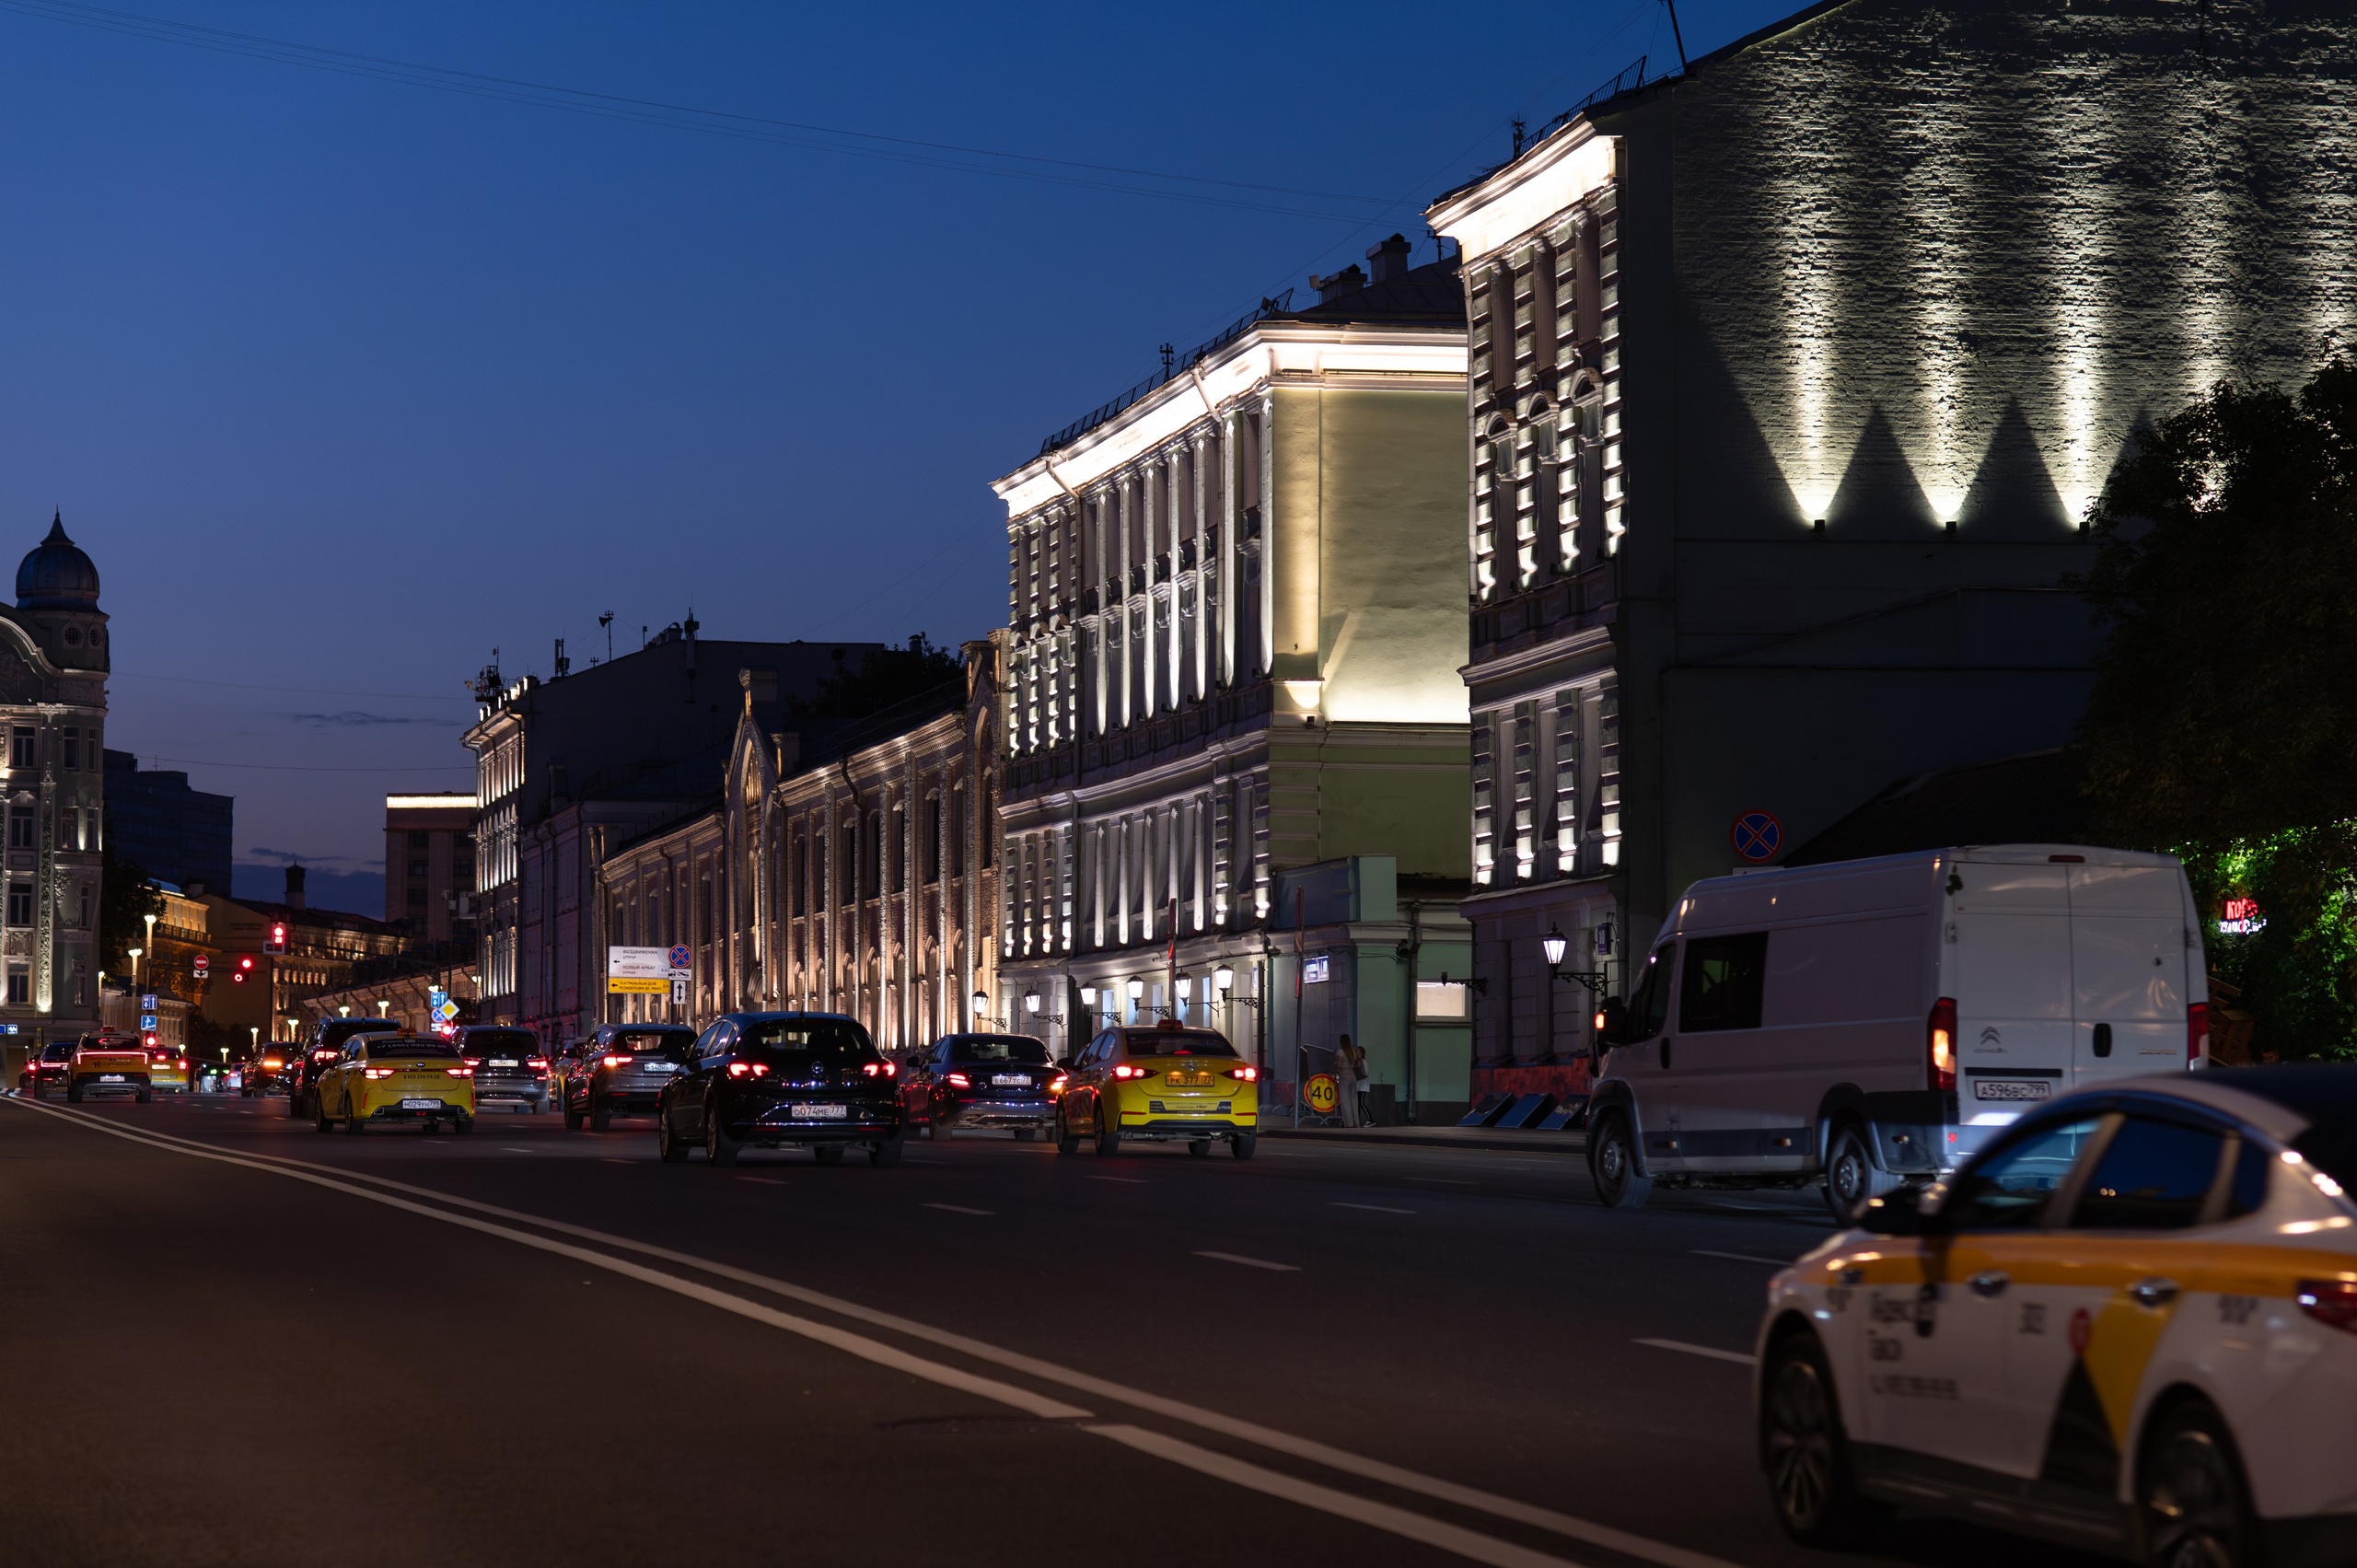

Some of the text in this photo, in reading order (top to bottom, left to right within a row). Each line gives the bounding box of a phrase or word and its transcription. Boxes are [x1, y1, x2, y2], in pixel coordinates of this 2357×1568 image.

[1183, 1076, 1199, 1085] 377
[1312, 1086, 1333, 1101] 40
[1980, 1083, 2047, 1098] А596ВС 799
[794, 1106, 844, 1116] О074МЕ 777
